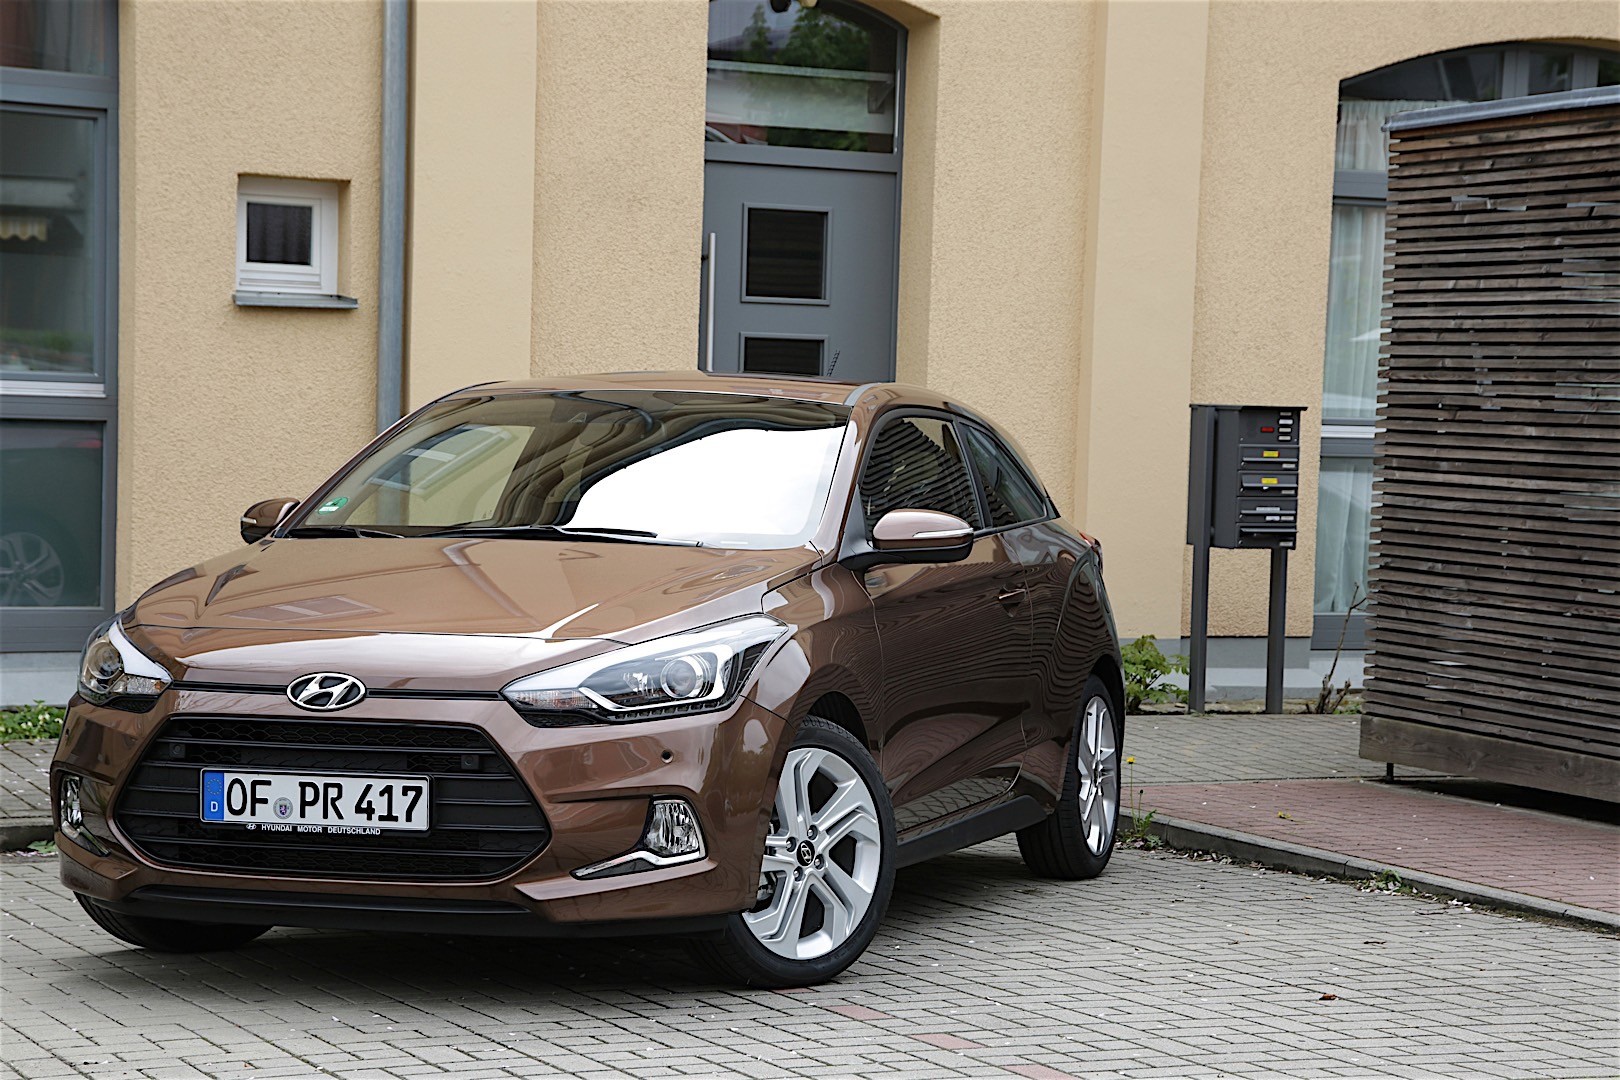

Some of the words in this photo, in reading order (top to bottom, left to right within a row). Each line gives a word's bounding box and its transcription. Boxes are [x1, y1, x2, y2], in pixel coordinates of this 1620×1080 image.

[226, 778, 272, 816] OF
[298, 781, 344, 819] PR
[354, 783, 423, 822] 417
[211, 802, 218, 812] D
[261, 824, 292, 832] HYUNDAI
[297, 825, 323, 833] MOTOR
[327, 826, 381, 835] DEUTSCHLAND
